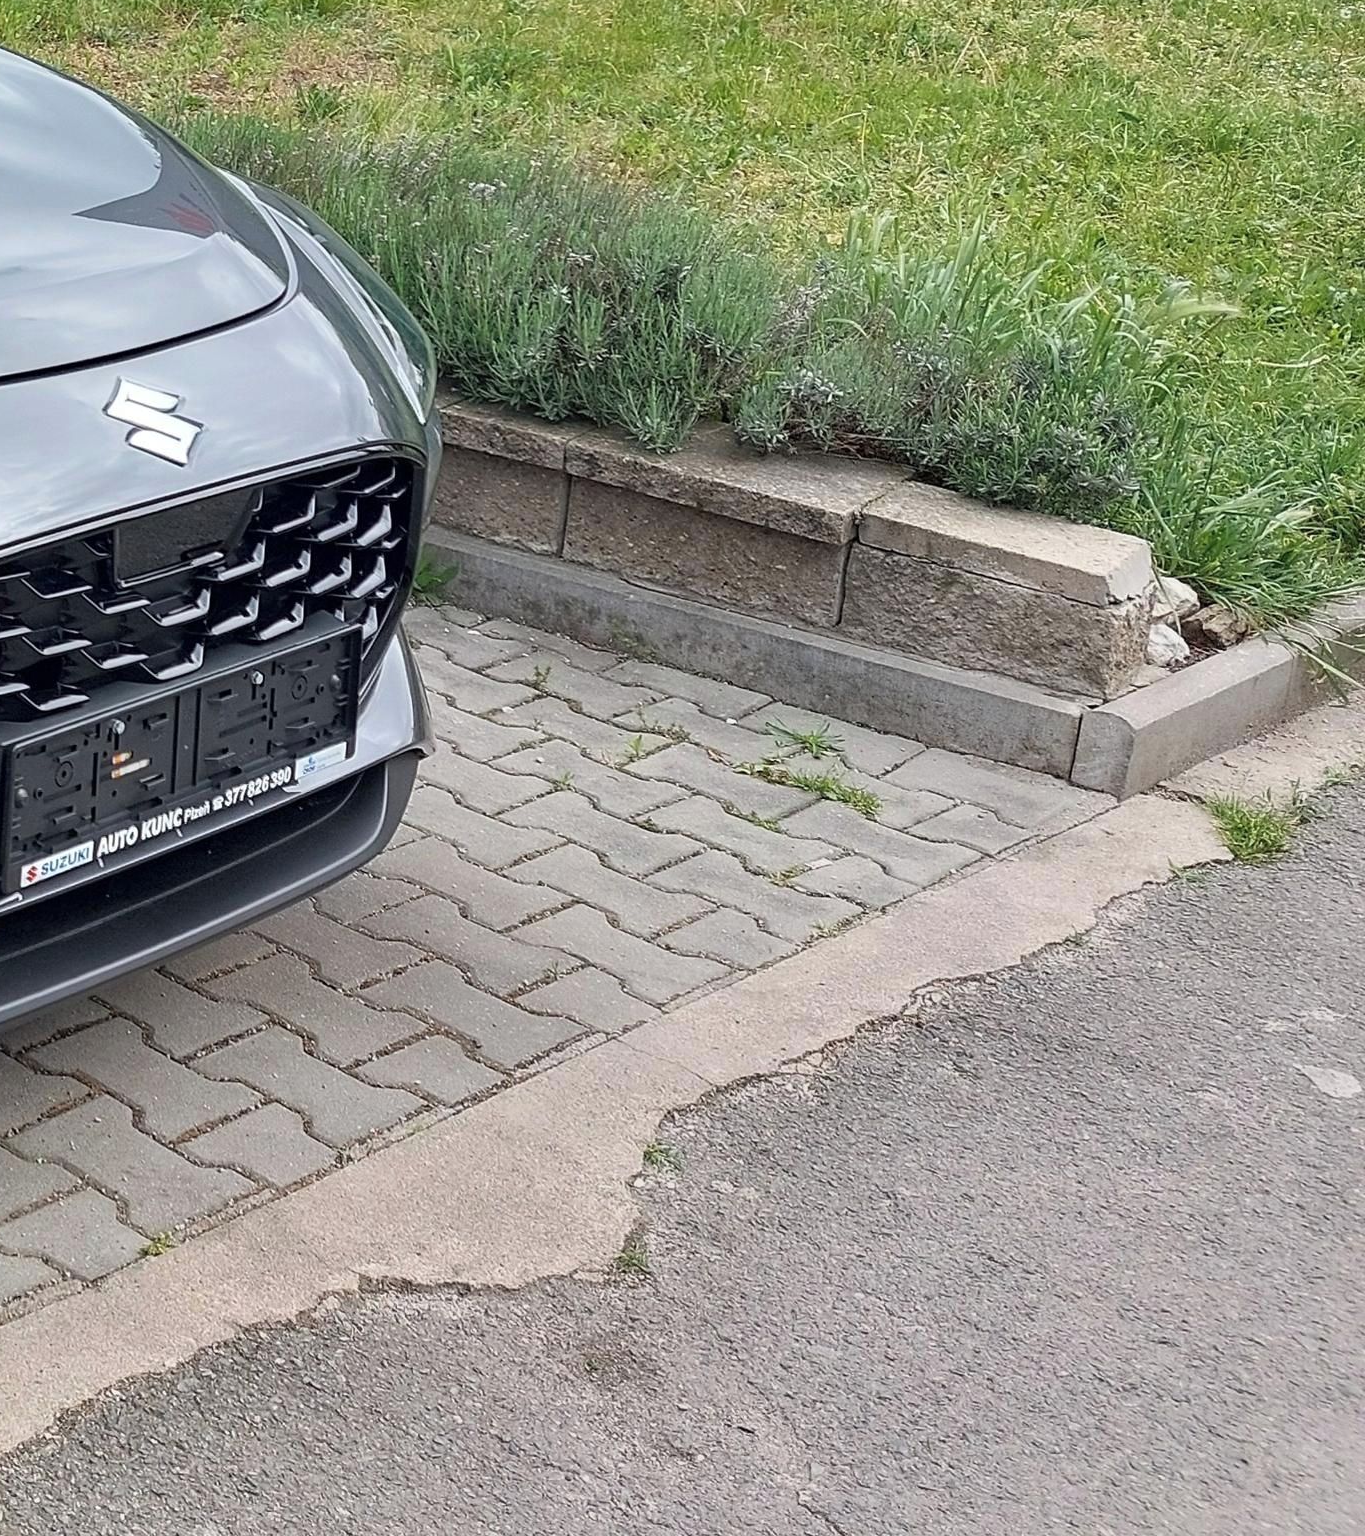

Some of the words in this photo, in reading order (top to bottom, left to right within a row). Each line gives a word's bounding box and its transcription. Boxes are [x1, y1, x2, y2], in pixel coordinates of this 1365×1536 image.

[40, 847, 91, 876] SUZUKI
[97, 825, 139, 858] AUTO
[140, 807, 184, 842] KUNC
